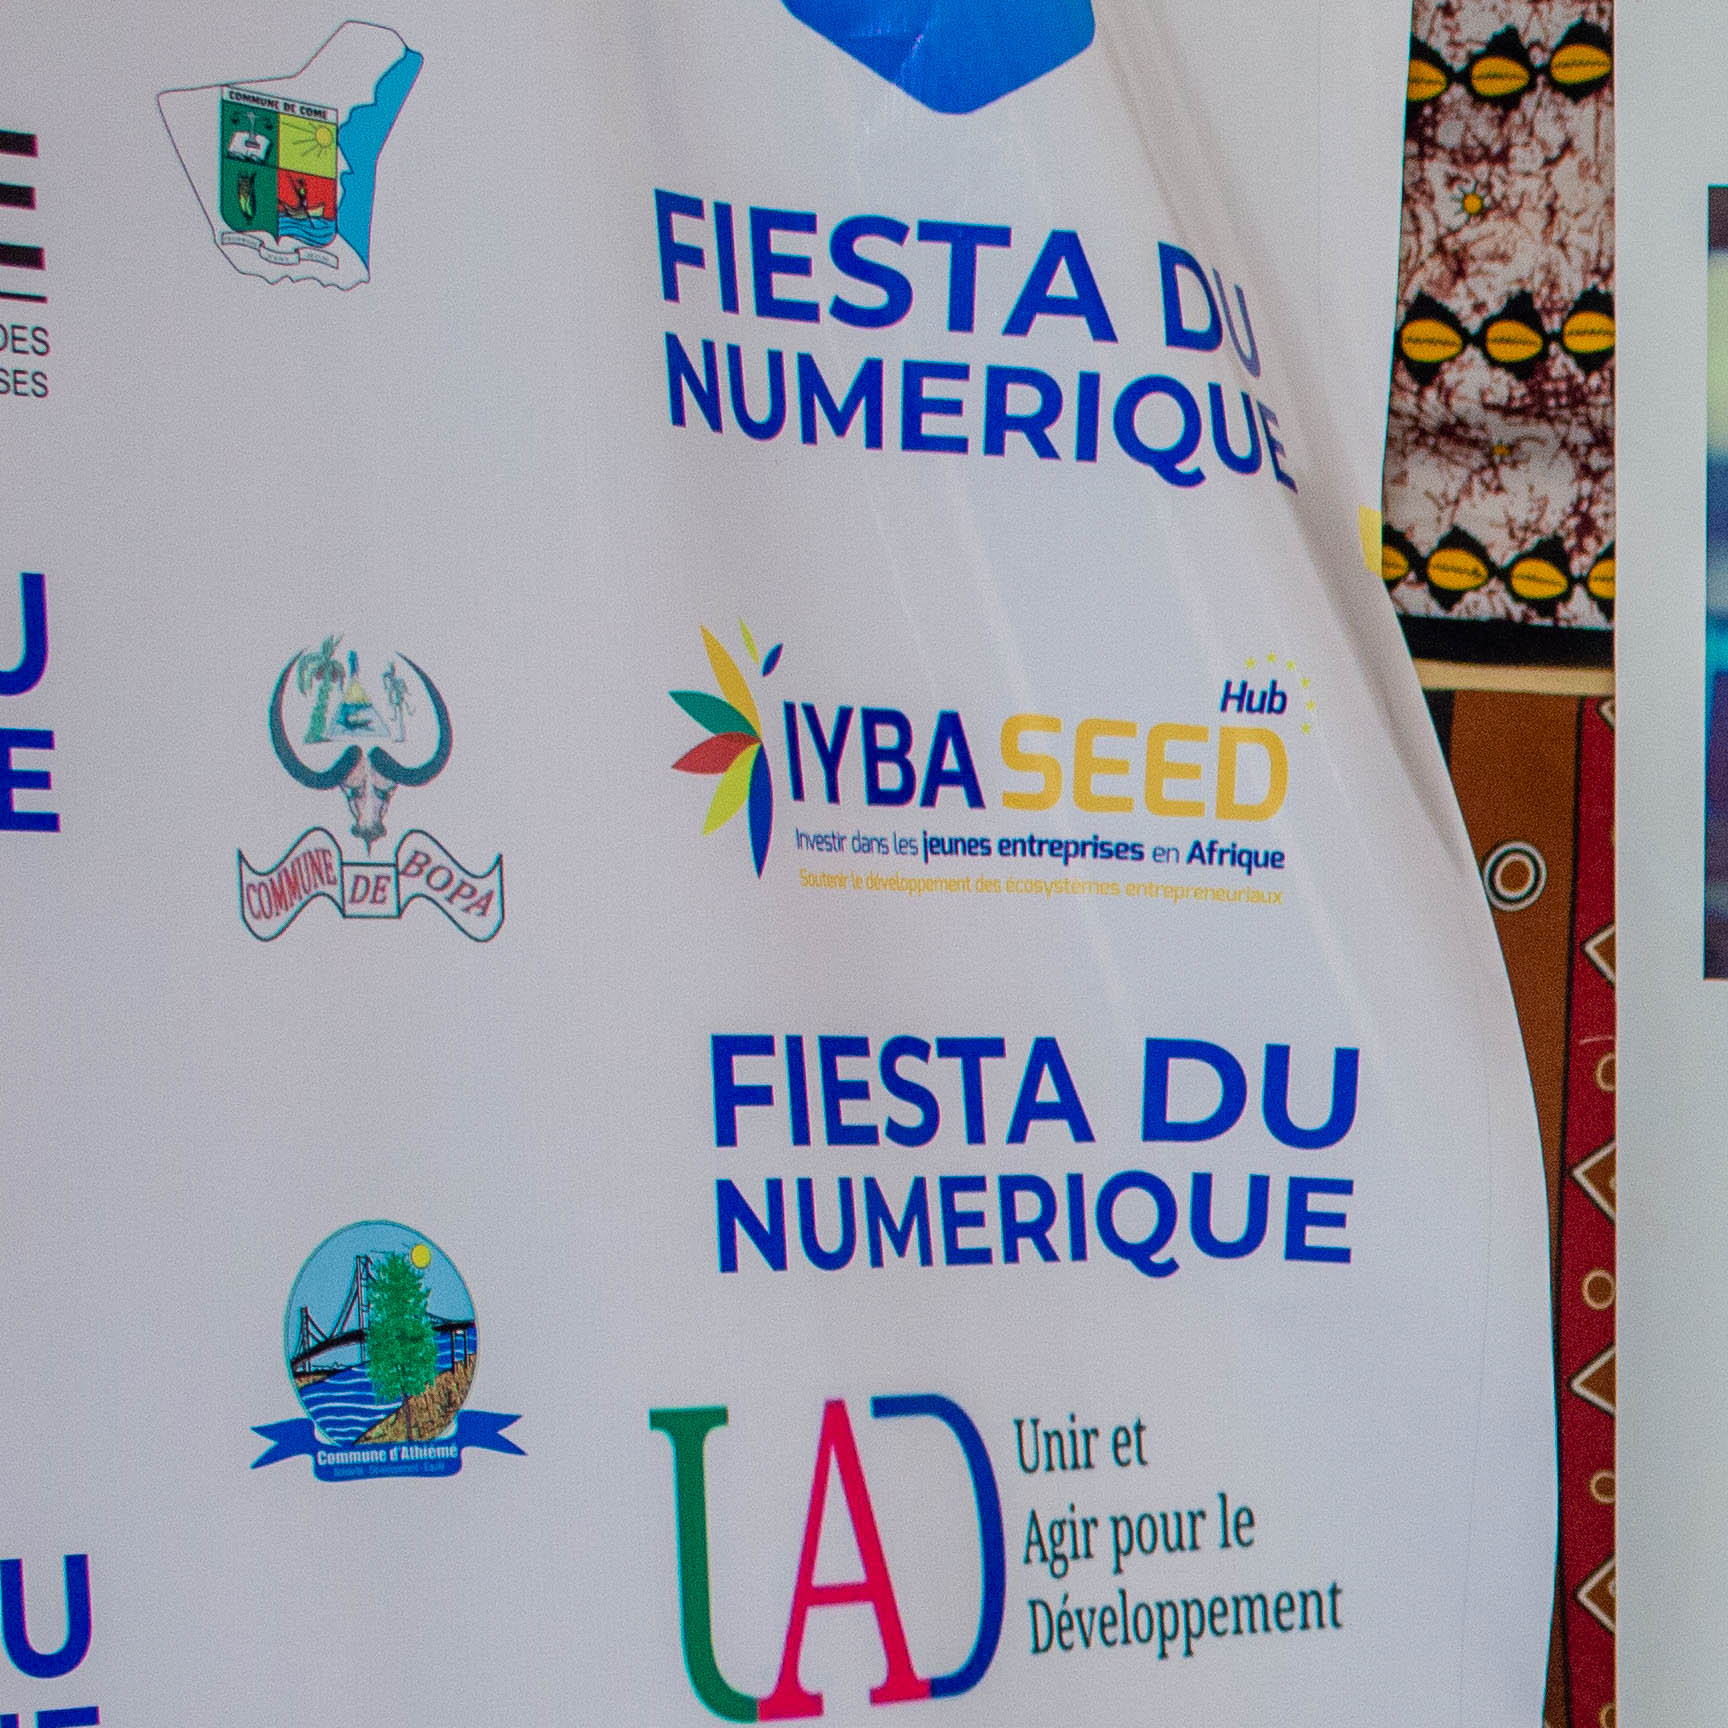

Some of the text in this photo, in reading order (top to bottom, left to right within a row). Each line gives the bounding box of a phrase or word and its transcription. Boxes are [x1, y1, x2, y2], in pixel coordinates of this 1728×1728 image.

[654, 188, 1262, 377] FIESTA DU
[665, 331, 1298, 493] NUMERIQUE
[1219, 679, 1288, 716] Hub
[782, 700, 1288, 822] IYBA SEED
[244, 848, 495, 922] COMMUNE DE BOPA
[795, 826, 1286, 876] Investir dans les jeunes entreprises en Afrique
[710, 1034, 1360, 1150] FIESTA DU
[715, 1170, 1355, 1278] NUMERIQUE
[316, 1449, 387, 1466] Commune
[1013, 1414, 1148, 1474] Unir et
[1023, 1492, 1256, 1579] Agir pour le
[1028, 1580, 1344, 1660] Développement
